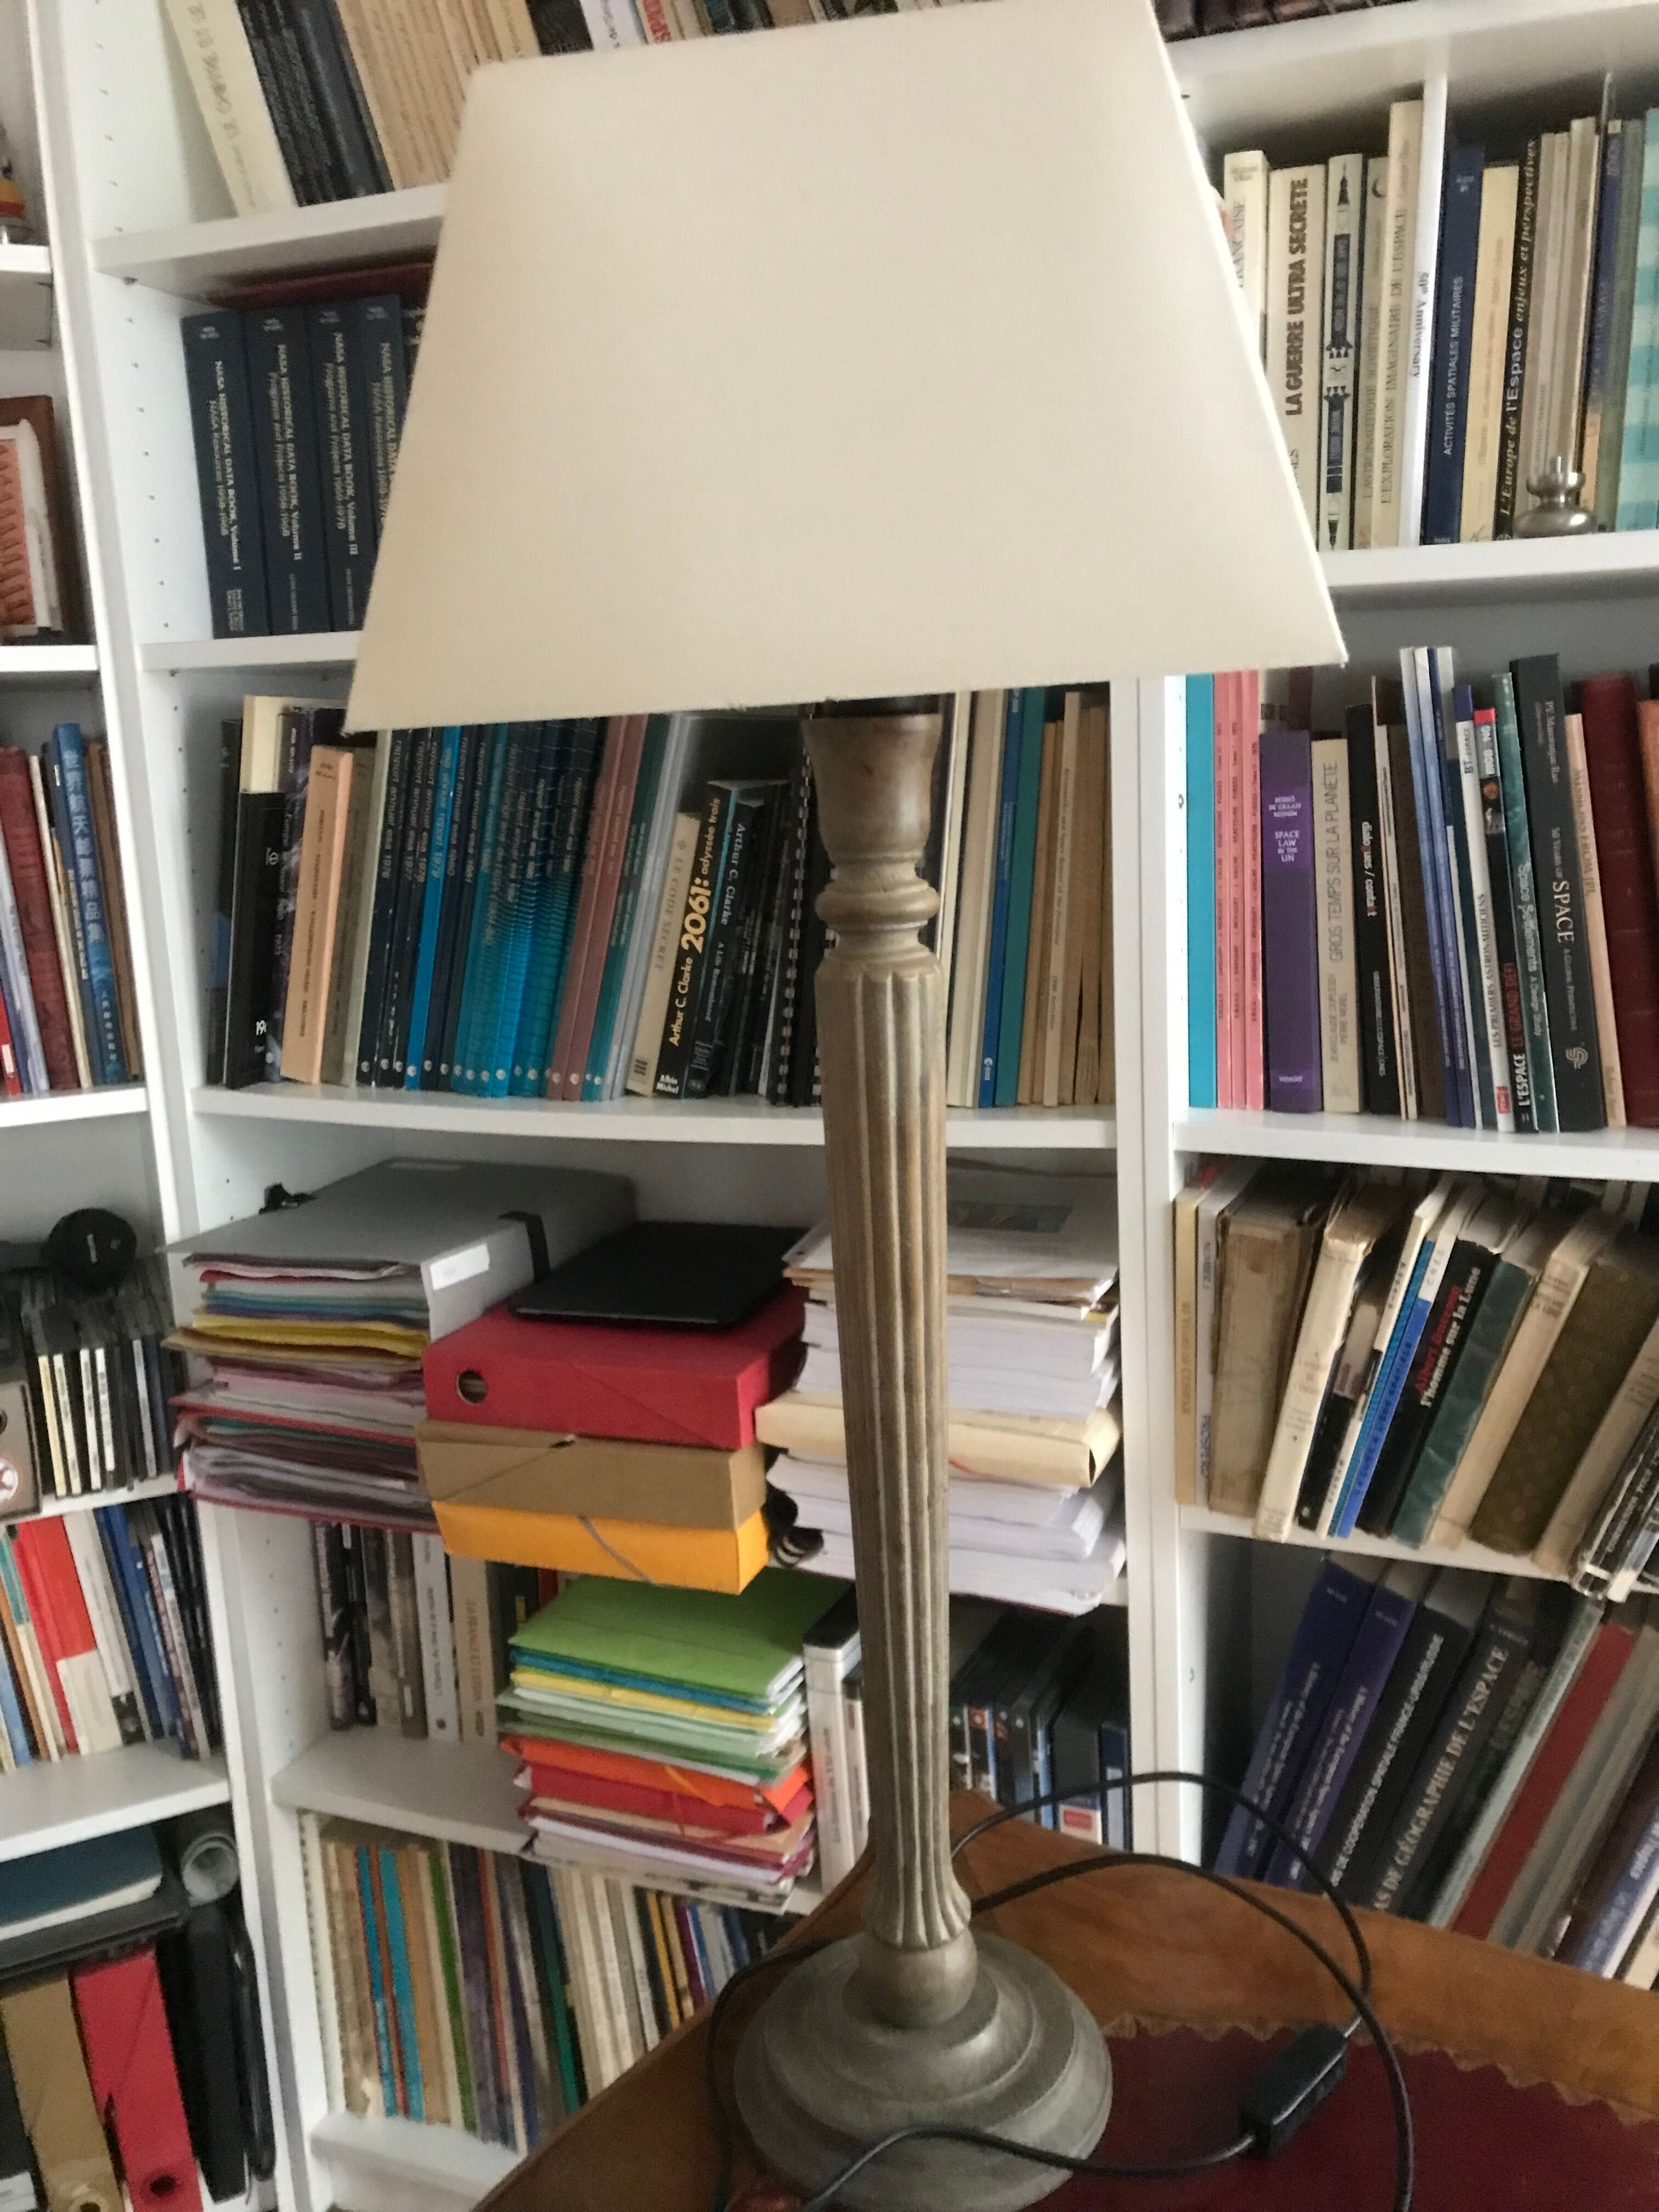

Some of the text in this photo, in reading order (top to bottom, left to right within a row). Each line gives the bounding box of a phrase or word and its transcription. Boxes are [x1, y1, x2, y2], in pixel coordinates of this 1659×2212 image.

[1520, 246, 1529, 261] et
[1287, 259, 1306, 314] ULTRA
[1390, 281, 1402, 297] DE
[1451, 275, 1464, 337] MILITAIRES
[334, 332, 345, 363] NASA
[1285, 320, 1304, 391] GUERRE
[1411, 301, 1426, 377] Anniversary
[277, 344, 287, 374] NASA
[1447, 341, 1460, 399] SPATIALES
[1285, 393, 1302, 415] LA
[1505, 416, 1516, 435] de
[214, 361, 225, 391] NASA
[224, 459, 234, 486] DATA
[229, 525, 241, 563] Volume
[285, 443, 296, 471] DATA
[341, 432, 352, 461] DATA
[1499, 442, 1516, 516] L'Europe
[290, 511, 302, 550] Volume
[346, 501, 357, 541] Volume
[1464, 761, 1474, 774] BT
[707, 797, 723, 824] trois
[1274, 830, 1300, 839] SPACE
[1325, 825, 1339, 844] LA
[719, 823, 747, 925] Arthur C. Clarke
[1281, 854, 1295, 862] UN
[1326, 846, 1341, 874] SUR
[1327, 878, 1341, 921] TEMPS
[1517, 862, 1531, 902] Space
[679, 877, 714, 953] 2061:
[1553, 880, 1575, 945] SPACE
[1329, 925, 1344, 962] GROS
[676, 956, 694, 994] Clarke
[674, 996, 687, 1008] C.
[668, 1008, 686, 1046] Arthur
[1513, 1053, 1531, 1107] L'ESPACE
[1458, 1266, 1481, 1305] Lune
[1452, 1305, 1468, 1321] la
[1445, 1321, 1461, 1346] sur
[1456, 1645, 1510, 1731] L'ESPACE
[1446, 1730, 1469, 1757] DE
